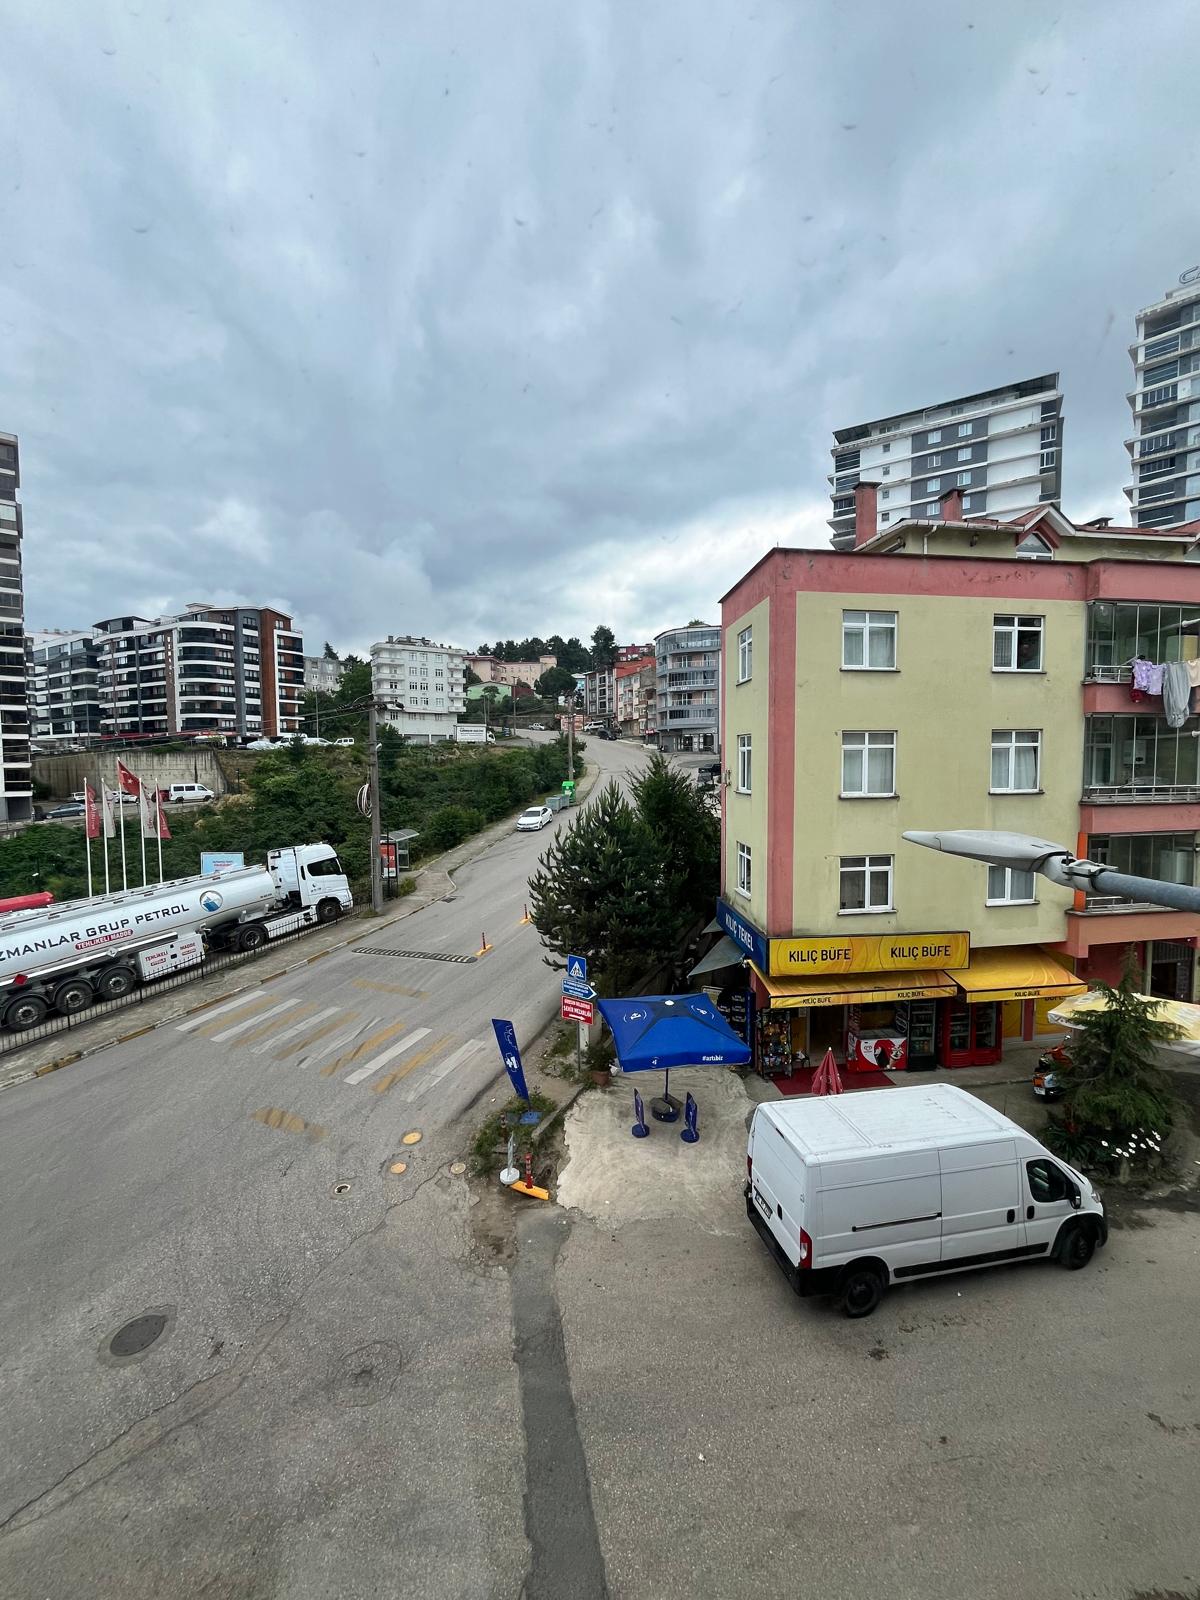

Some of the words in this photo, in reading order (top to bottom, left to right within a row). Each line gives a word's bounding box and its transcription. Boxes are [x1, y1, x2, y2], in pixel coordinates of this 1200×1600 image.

[86, 918, 130, 937] GRUP
[135, 904, 190, 924] PETROL
[738, 925, 754, 951] TEKEL
[789, 950, 818, 964] KILIÇ
[820, 947, 851, 961] BÜFE
[890, 946, 919, 961] KILIÇ
[921, 944, 951, 957] BÜFE
